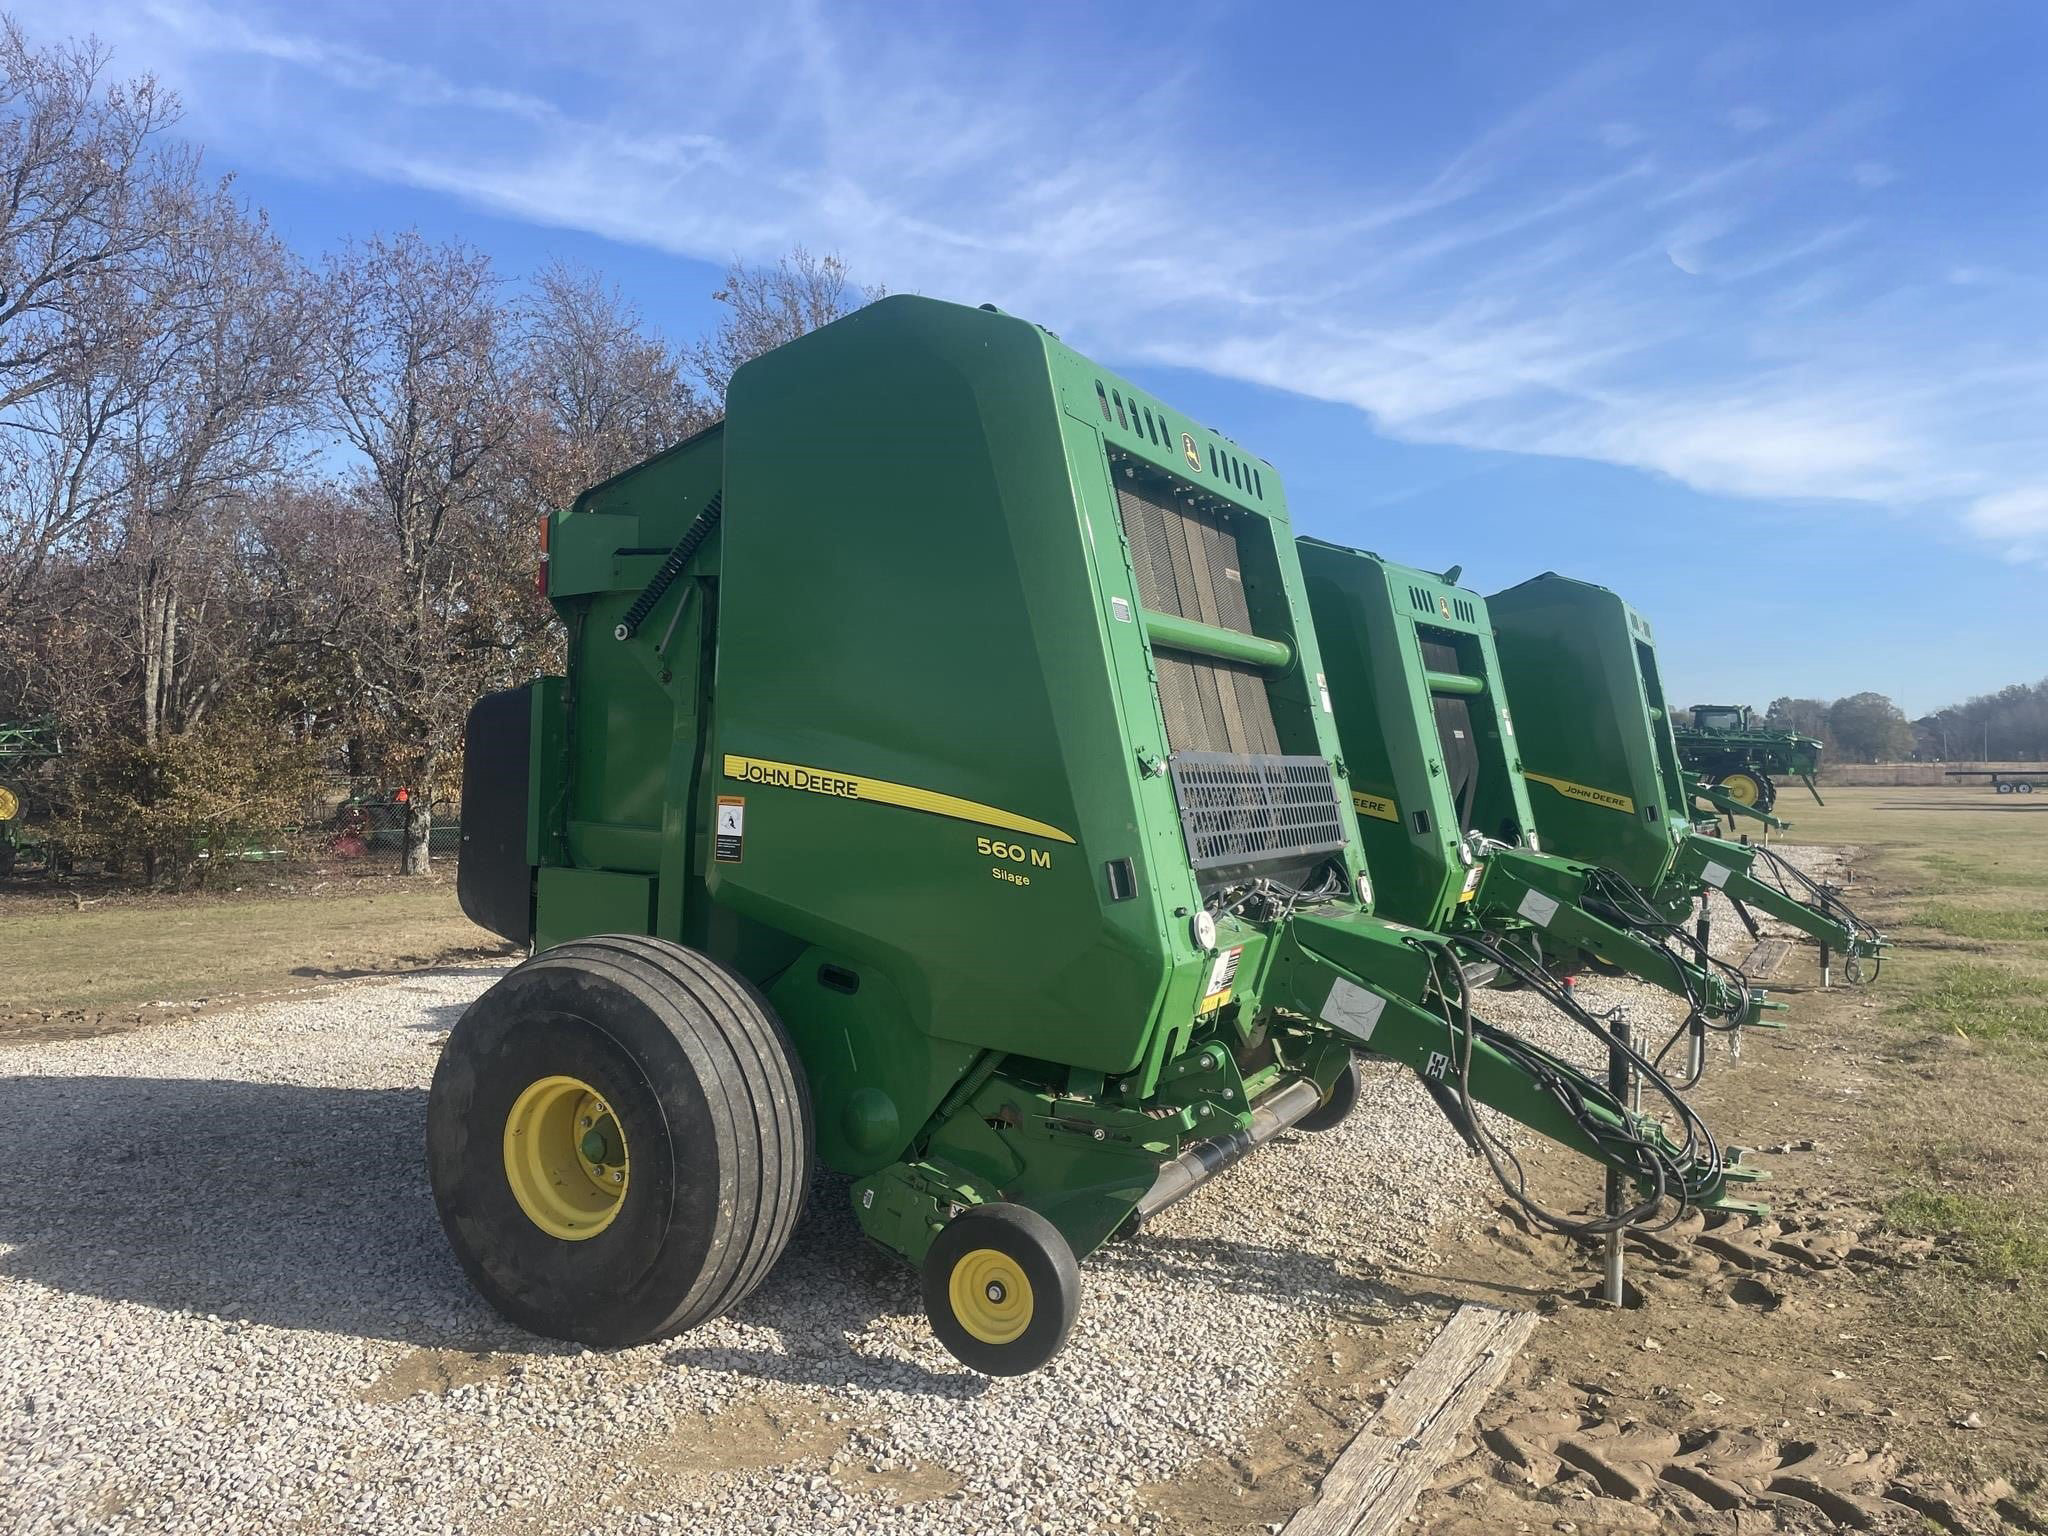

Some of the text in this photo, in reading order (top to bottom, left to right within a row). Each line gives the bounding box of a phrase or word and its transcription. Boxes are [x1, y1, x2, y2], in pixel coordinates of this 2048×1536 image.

[738, 761, 859, 798] JOHN DEERE
[1353, 797, 1386, 813] EERE
[1565, 785, 1626, 807] JOHN DEERE
[976, 836, 1052, 870] 560 M
[992, 867, 1031, 887] Silage
